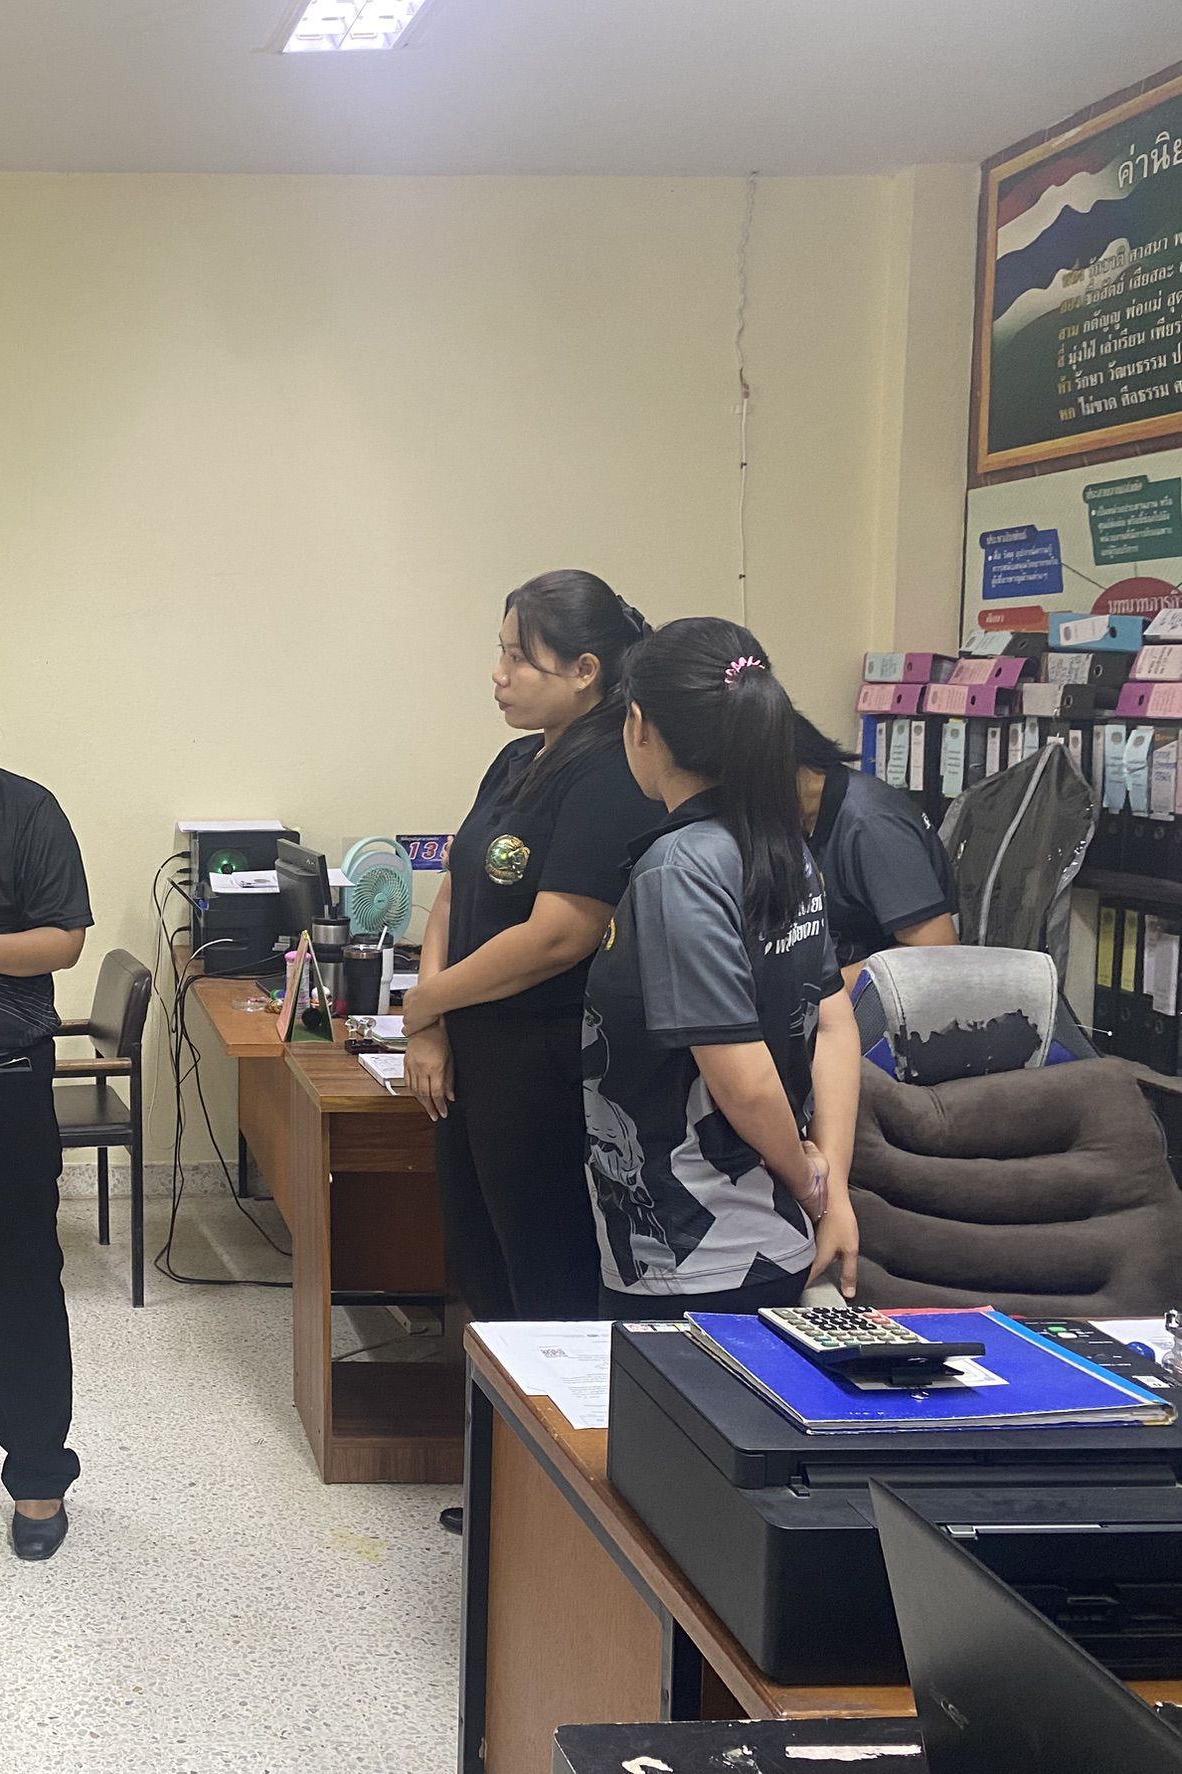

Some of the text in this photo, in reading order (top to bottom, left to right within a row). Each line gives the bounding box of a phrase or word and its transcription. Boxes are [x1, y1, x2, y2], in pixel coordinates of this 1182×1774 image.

[1129, 237, 1168, 262] ศาสนา
[1129, 264, 1174, 289] เสียสละ
[1082, 309, 1121, 333] กตัญญู
[1126, 290, 1162, 320] พ่อแม่
[1100, 328, 1146, 355] เล่าเรียน
[1075, 369, 1104, 390] รักษา
[1108, 354, 1167, 381] วัฒนธรรม
[1121, 384, 1170, 407] ศีลธรรม
